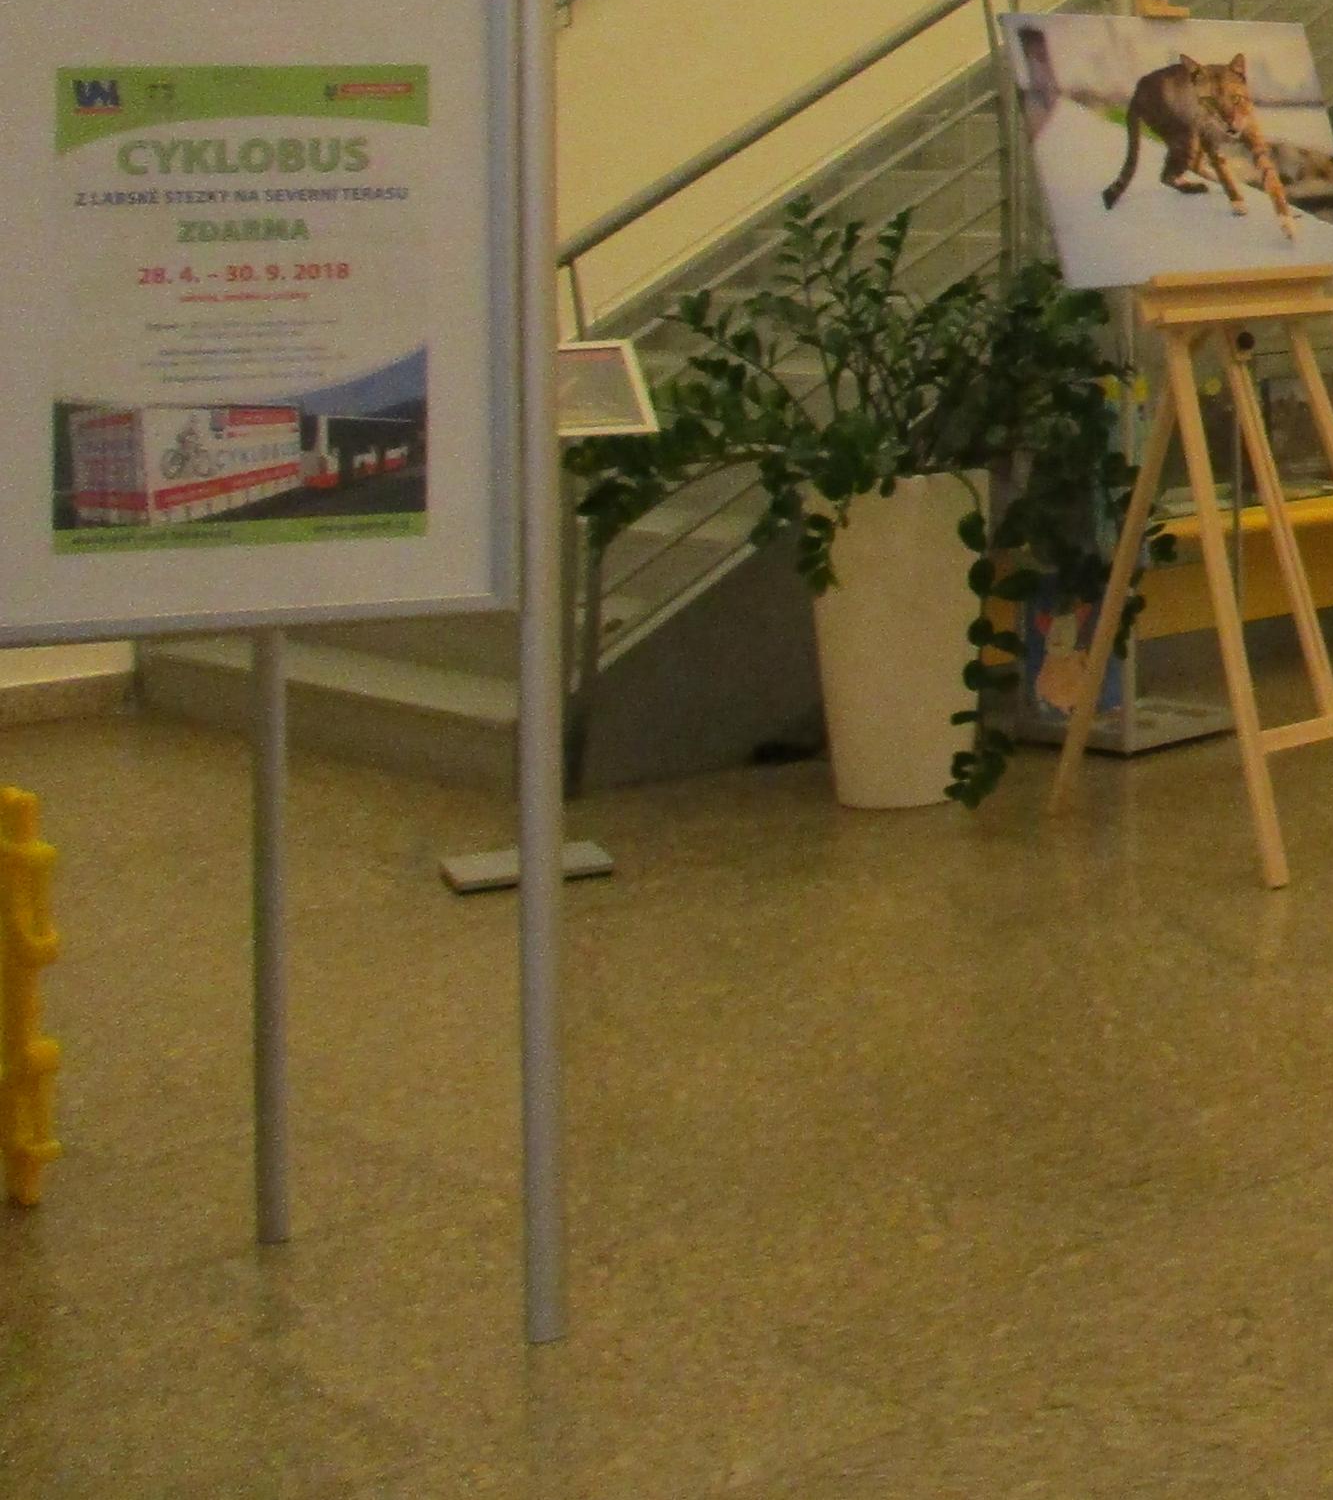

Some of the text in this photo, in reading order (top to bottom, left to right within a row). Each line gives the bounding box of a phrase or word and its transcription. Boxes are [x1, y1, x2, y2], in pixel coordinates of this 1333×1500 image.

[116, 135, 371, 176] CYKLOBUS
[176, 217, 311, 243] ZDARMA
[293, 261, 350, 282] 2018
